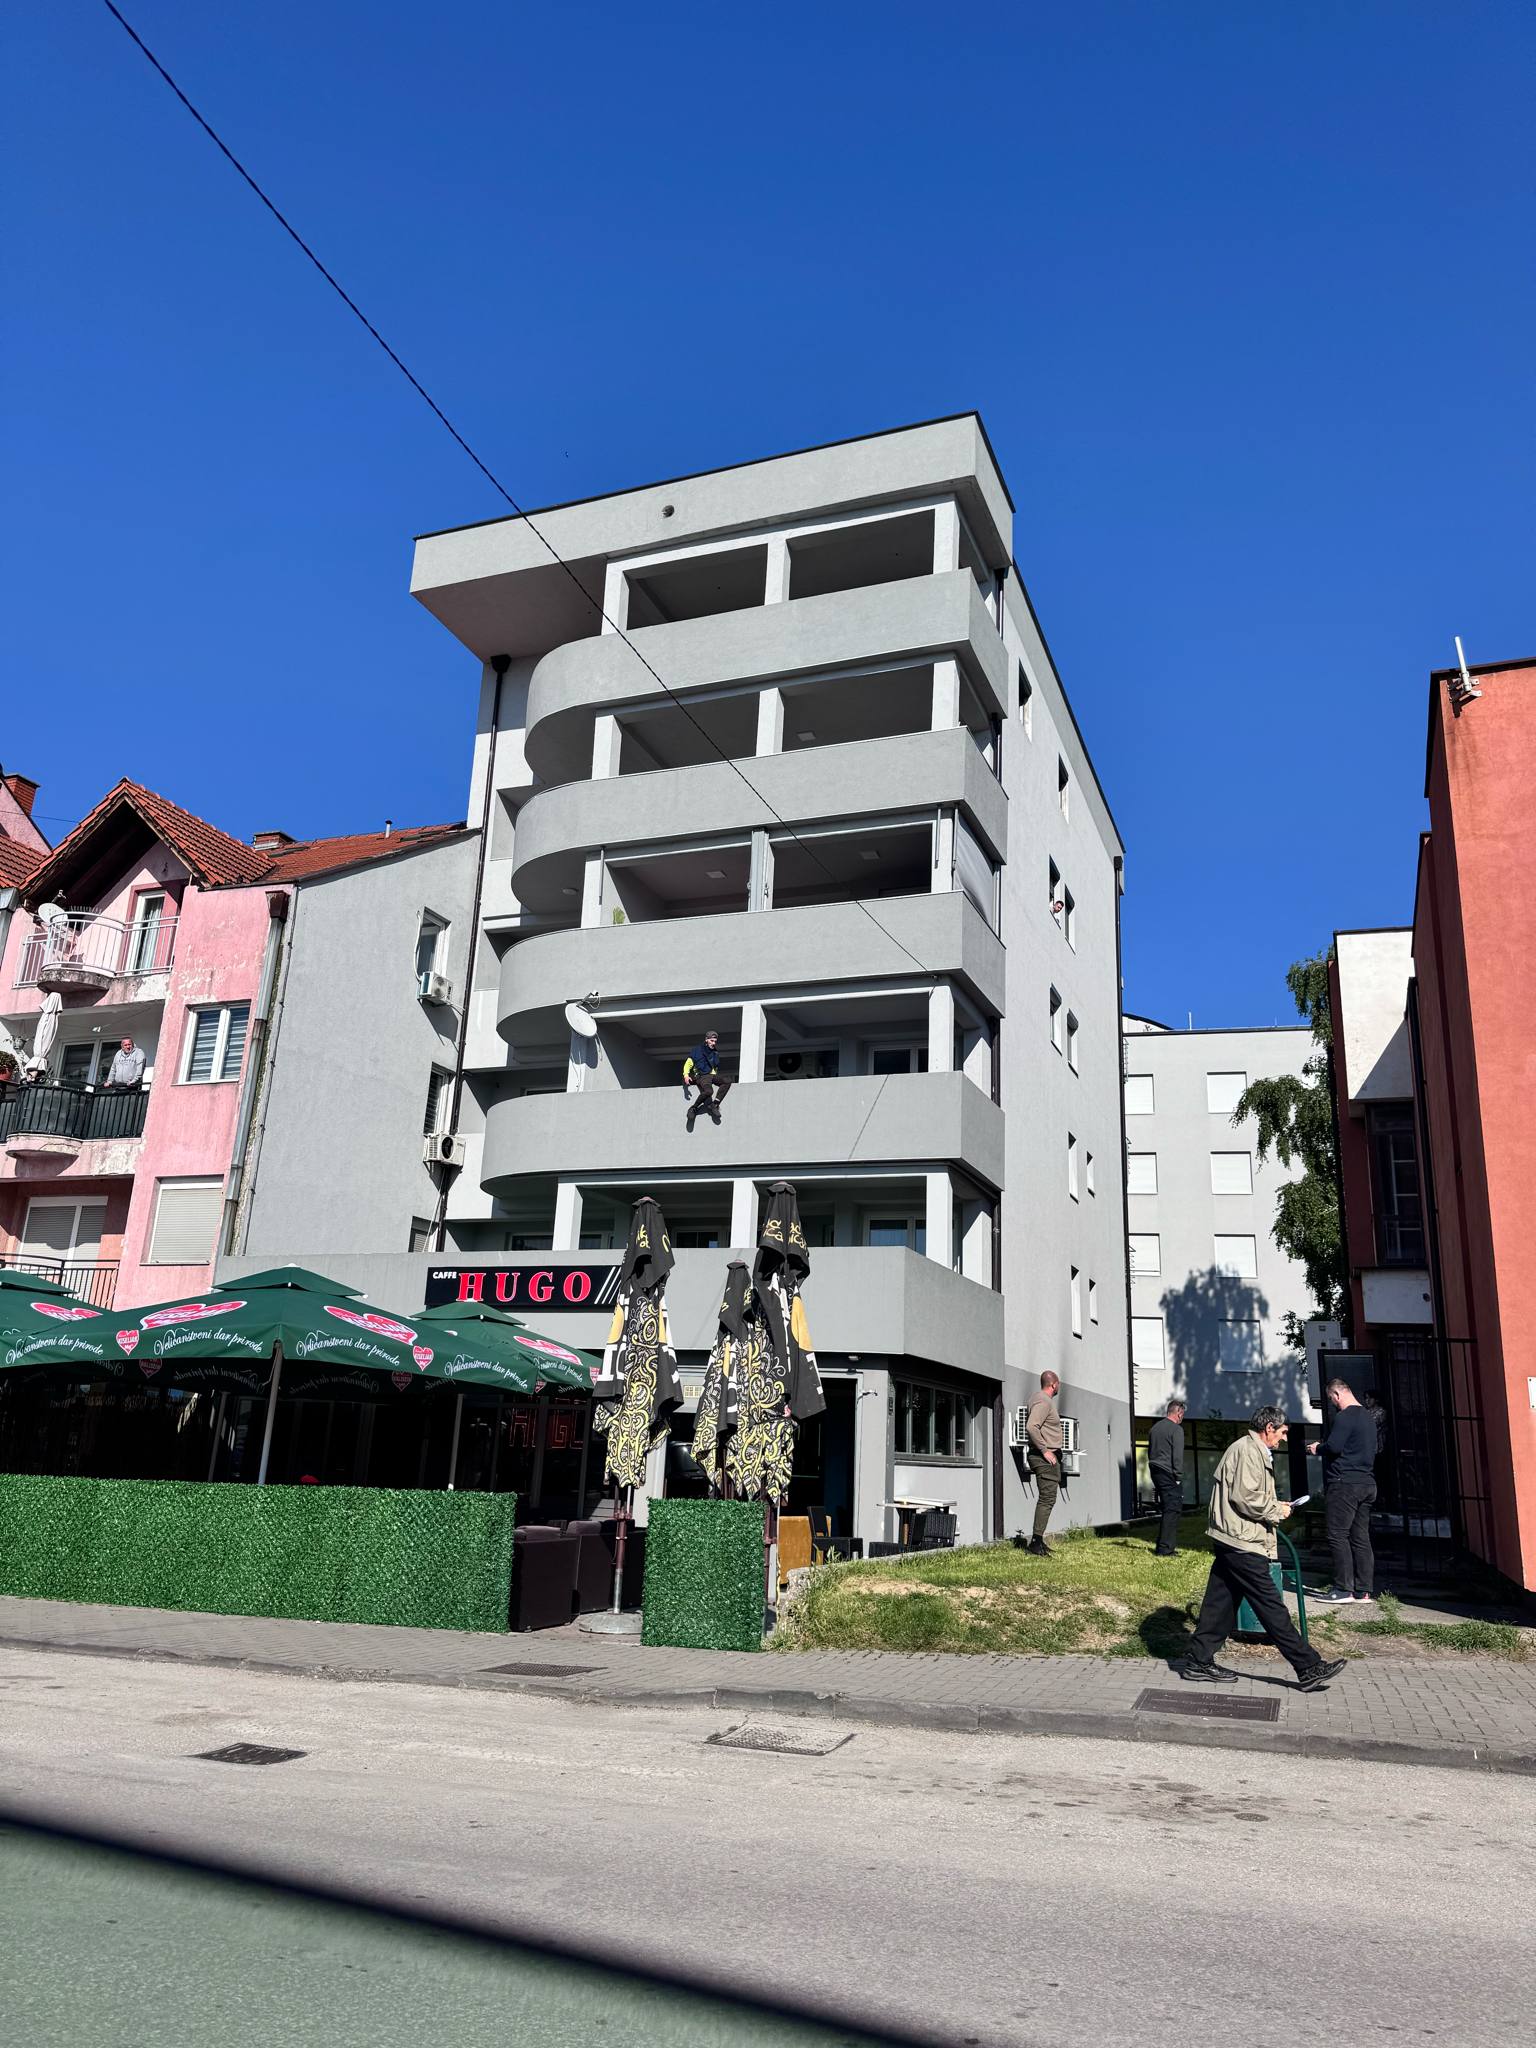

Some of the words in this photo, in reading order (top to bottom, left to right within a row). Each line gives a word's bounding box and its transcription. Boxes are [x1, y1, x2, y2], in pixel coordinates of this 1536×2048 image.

[433, 1271, 458, 1280] CAFFE
[456, 1271, 592, 1303] HUGO
[58, 1334, 74, 1346] dar
[70, 1338, 104, 1356] prirode
[213, 1327, 231, 1341] dar
[228, 1333, 264, 1353] prirode
[354, 1337, 371, 1350] dar
[368, 1344, 400, 1366] prirode
[492, 1360, 505, 1374] dar
[503, 1368, 528, 1390] prirode
